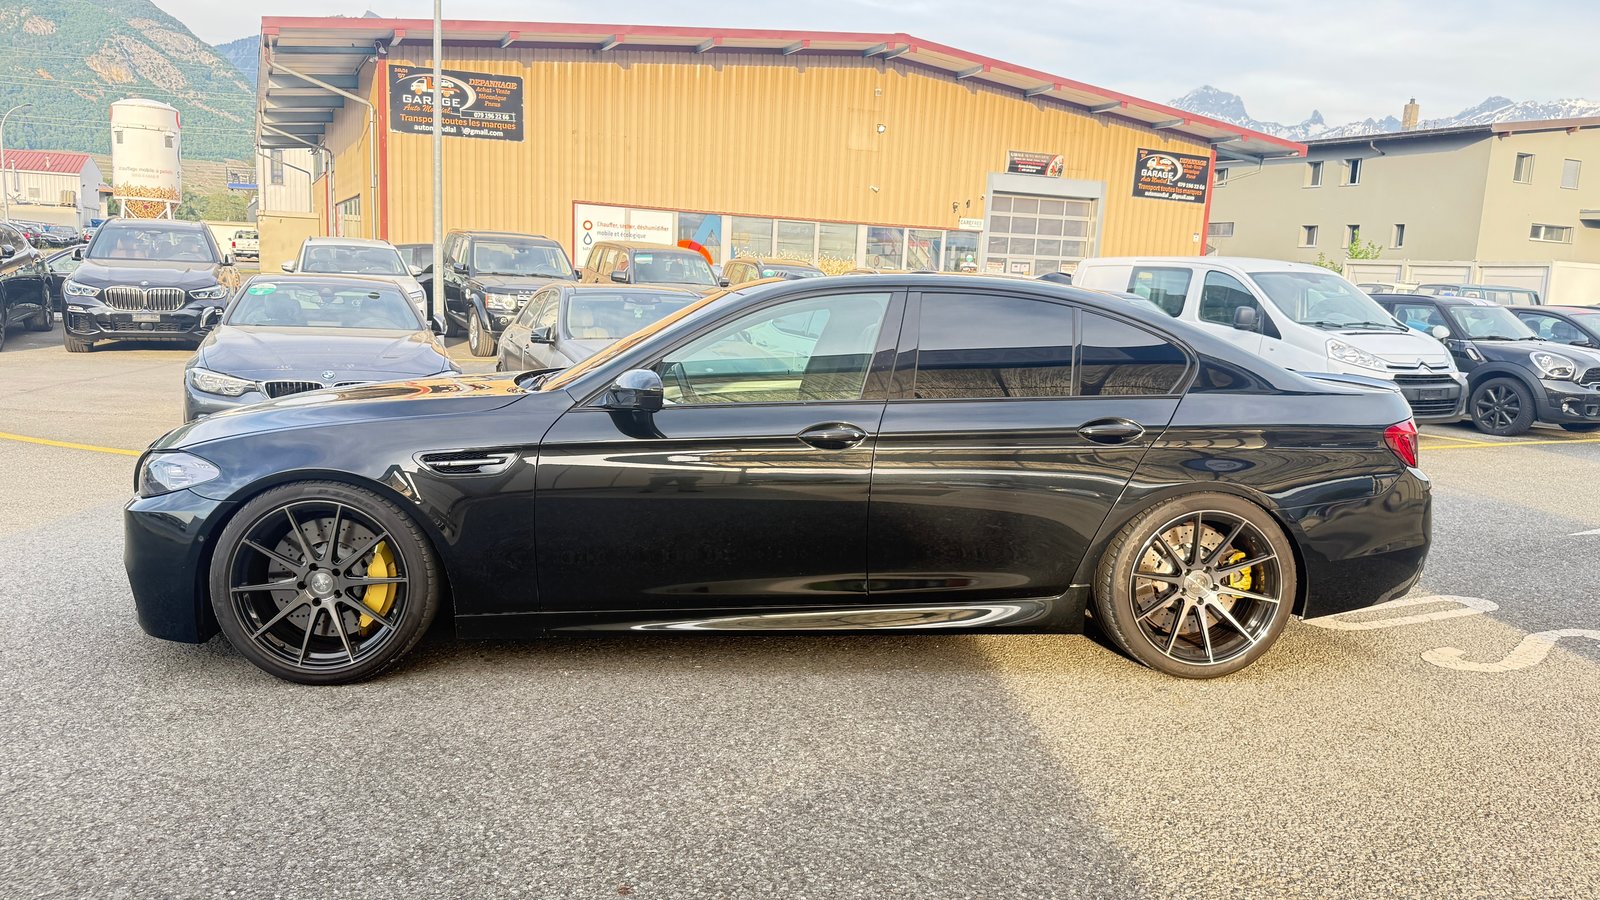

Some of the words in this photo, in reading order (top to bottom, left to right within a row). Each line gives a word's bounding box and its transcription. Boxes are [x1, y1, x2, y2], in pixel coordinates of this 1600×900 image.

[469, 78, 518, 89] DEPANNAGE
[402, 94, 460, 108] GARGE
[403, 104, 420, 112] Auto
[400, 114, 435, 124] Transpo
[442, 118, 467, 126] toutes
[482, 120, 516, 130] marques
[1141, 169, 1174, 179] GARAGE
[1138, 183, 1160, 192] Transport
